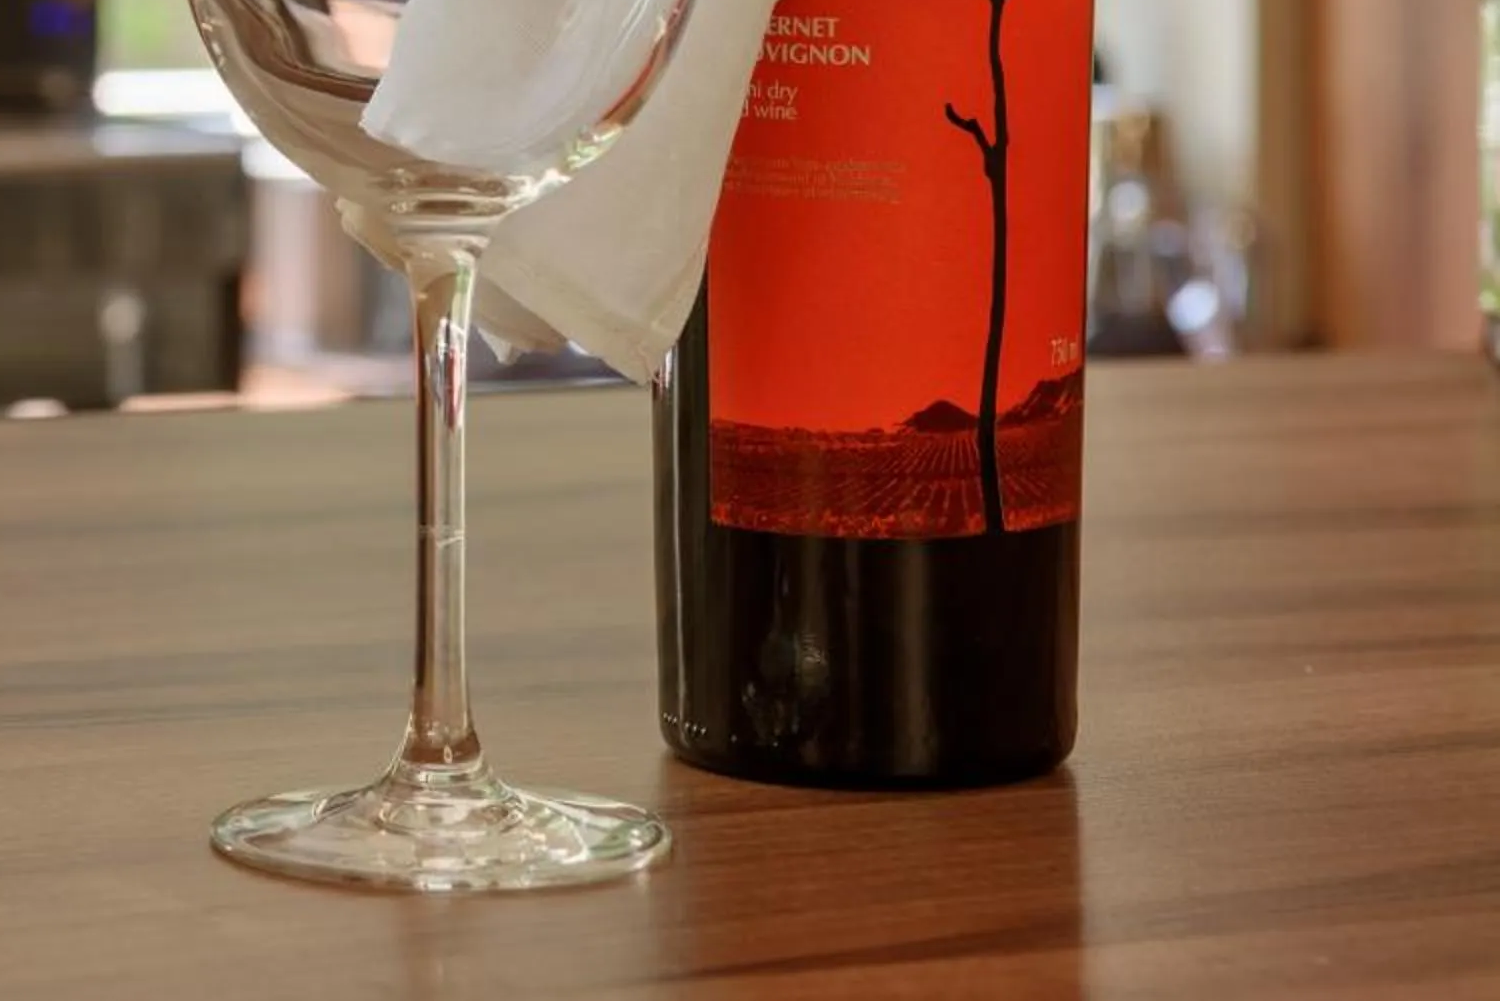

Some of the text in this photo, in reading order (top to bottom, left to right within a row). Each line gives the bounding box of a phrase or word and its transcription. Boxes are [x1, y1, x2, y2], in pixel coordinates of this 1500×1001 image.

[767, 15, 841, 39] ERNET
[767, 79, 798, 106] dry
[753, 100, 798, 120] wine
